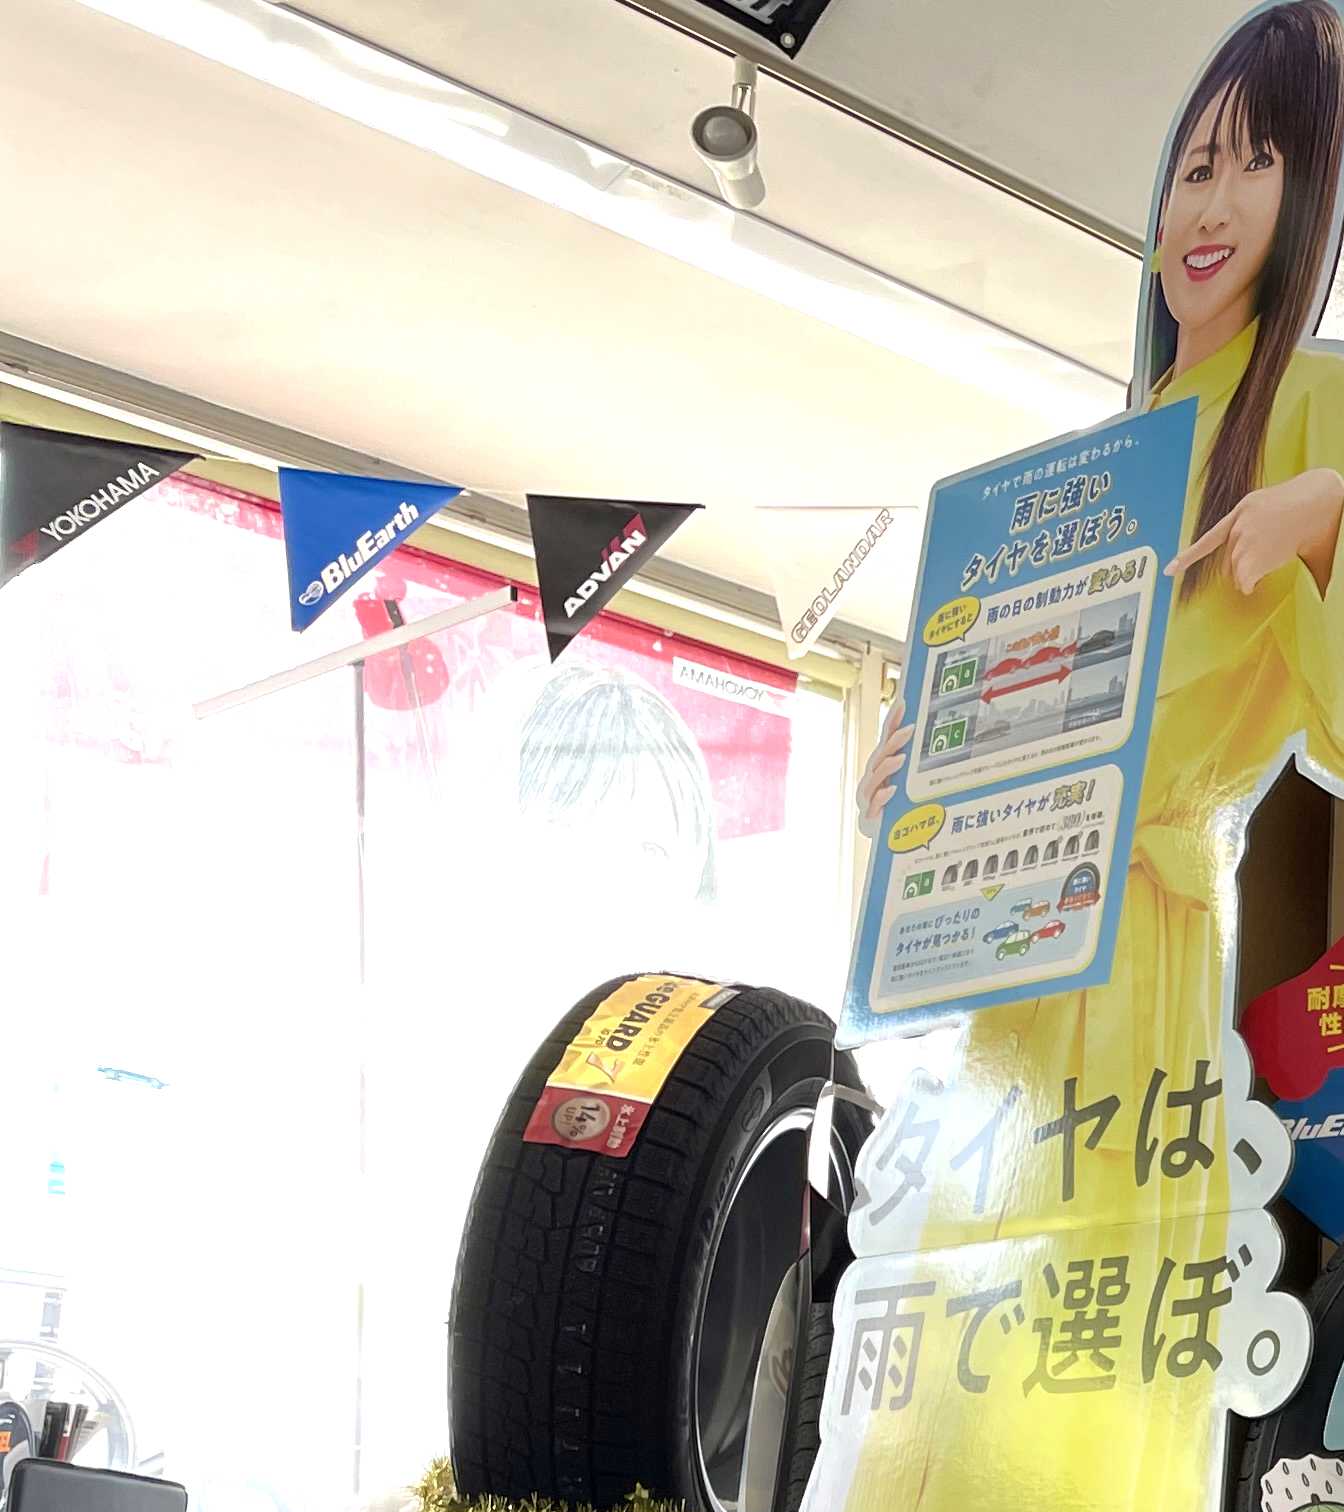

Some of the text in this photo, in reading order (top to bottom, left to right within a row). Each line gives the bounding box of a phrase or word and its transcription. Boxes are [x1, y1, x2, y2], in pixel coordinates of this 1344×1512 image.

[40, 459, 160, 545] YOKOHAMA
[320, 500, 420, 593] BluEarth
[1009, 472, 1111, 534] 雨に強い
[564, 530, 647, 619] ADVAN
[791, 508, 893, 644] GEOLANDAR
[960, 505, 1138, 591] タイヤを選ぼう。
[869, 1060, 1263, 1226] タイヤは、
[840, 1244, 1281, 1416] 雨で選ぼ。
